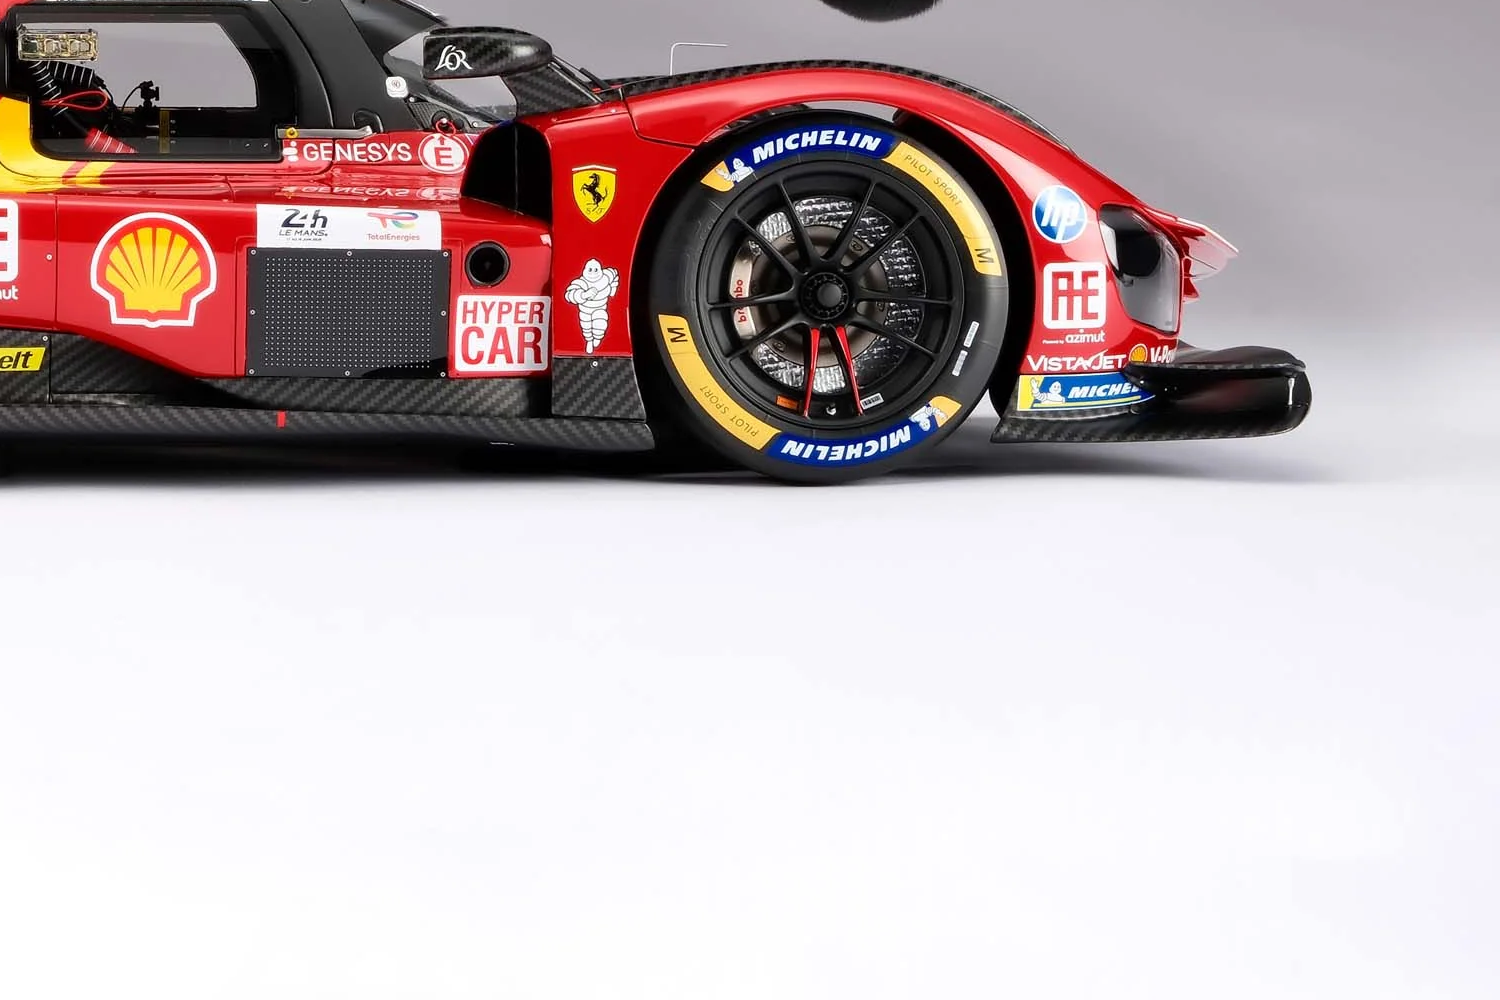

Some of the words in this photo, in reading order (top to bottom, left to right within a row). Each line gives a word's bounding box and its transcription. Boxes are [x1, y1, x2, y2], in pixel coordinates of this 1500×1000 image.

[303, 143, 412, 162] GENESYS
[752, 130, 881, 164] MICHELIN
[904, 153, 933, 177] PILOT
[933, 176, 963, 207] SPORT
[281, 208, 328, 228] 24h
[367, 233, 420, 242] TotalEnergies
[974, 248, 994, 264] M
[733, 279, 747, 322] brbo
[462, 301, 545, 324] HYPER
[461, 326, 542, 365] CAR
[670, 327, 688, 344] M
[1065, 329, 1105, 344] azimut
[700, 386, 730, 413] SPORT
[1068, 382, 1140, 398] MICHEL
[729, 415, 760, 437] PILOT
[781, 425, 911, 461] MICHELIN
